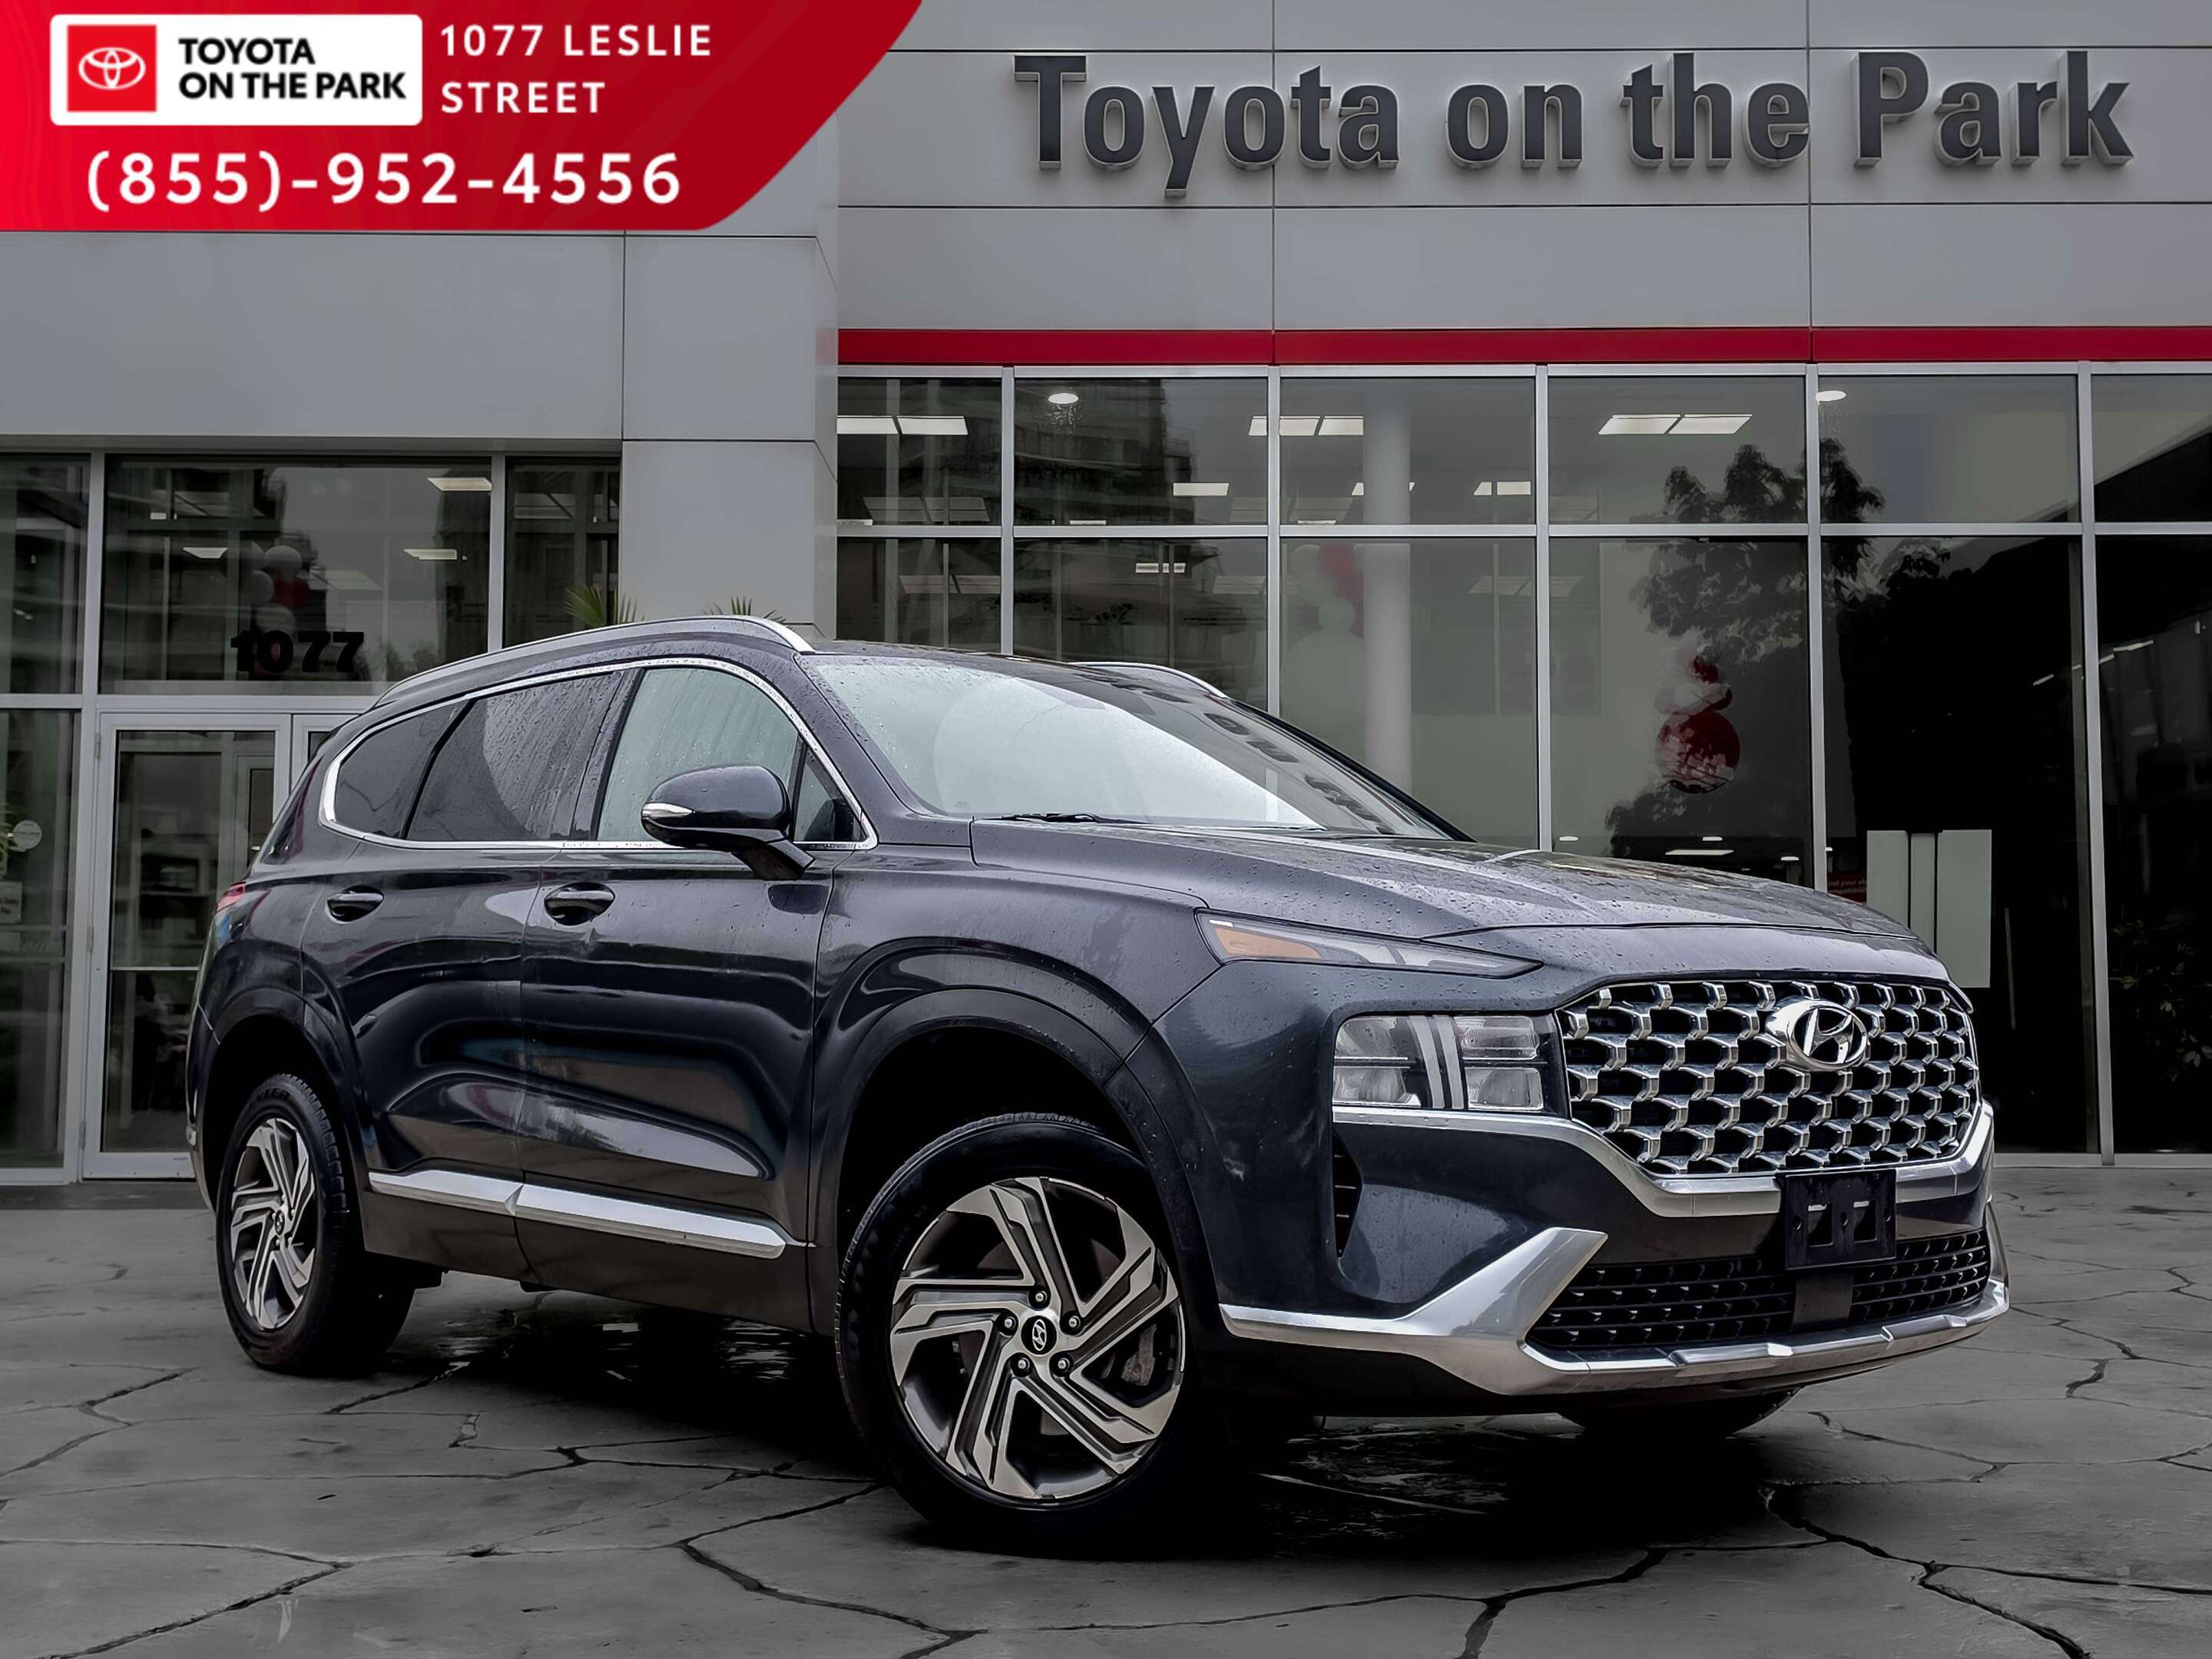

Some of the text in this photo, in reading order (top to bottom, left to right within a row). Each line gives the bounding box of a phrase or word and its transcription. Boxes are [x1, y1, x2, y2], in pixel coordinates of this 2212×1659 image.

[1014, 50, 2135, 197] Toyota on the Park
[230, 630, 365, 673] 1077
